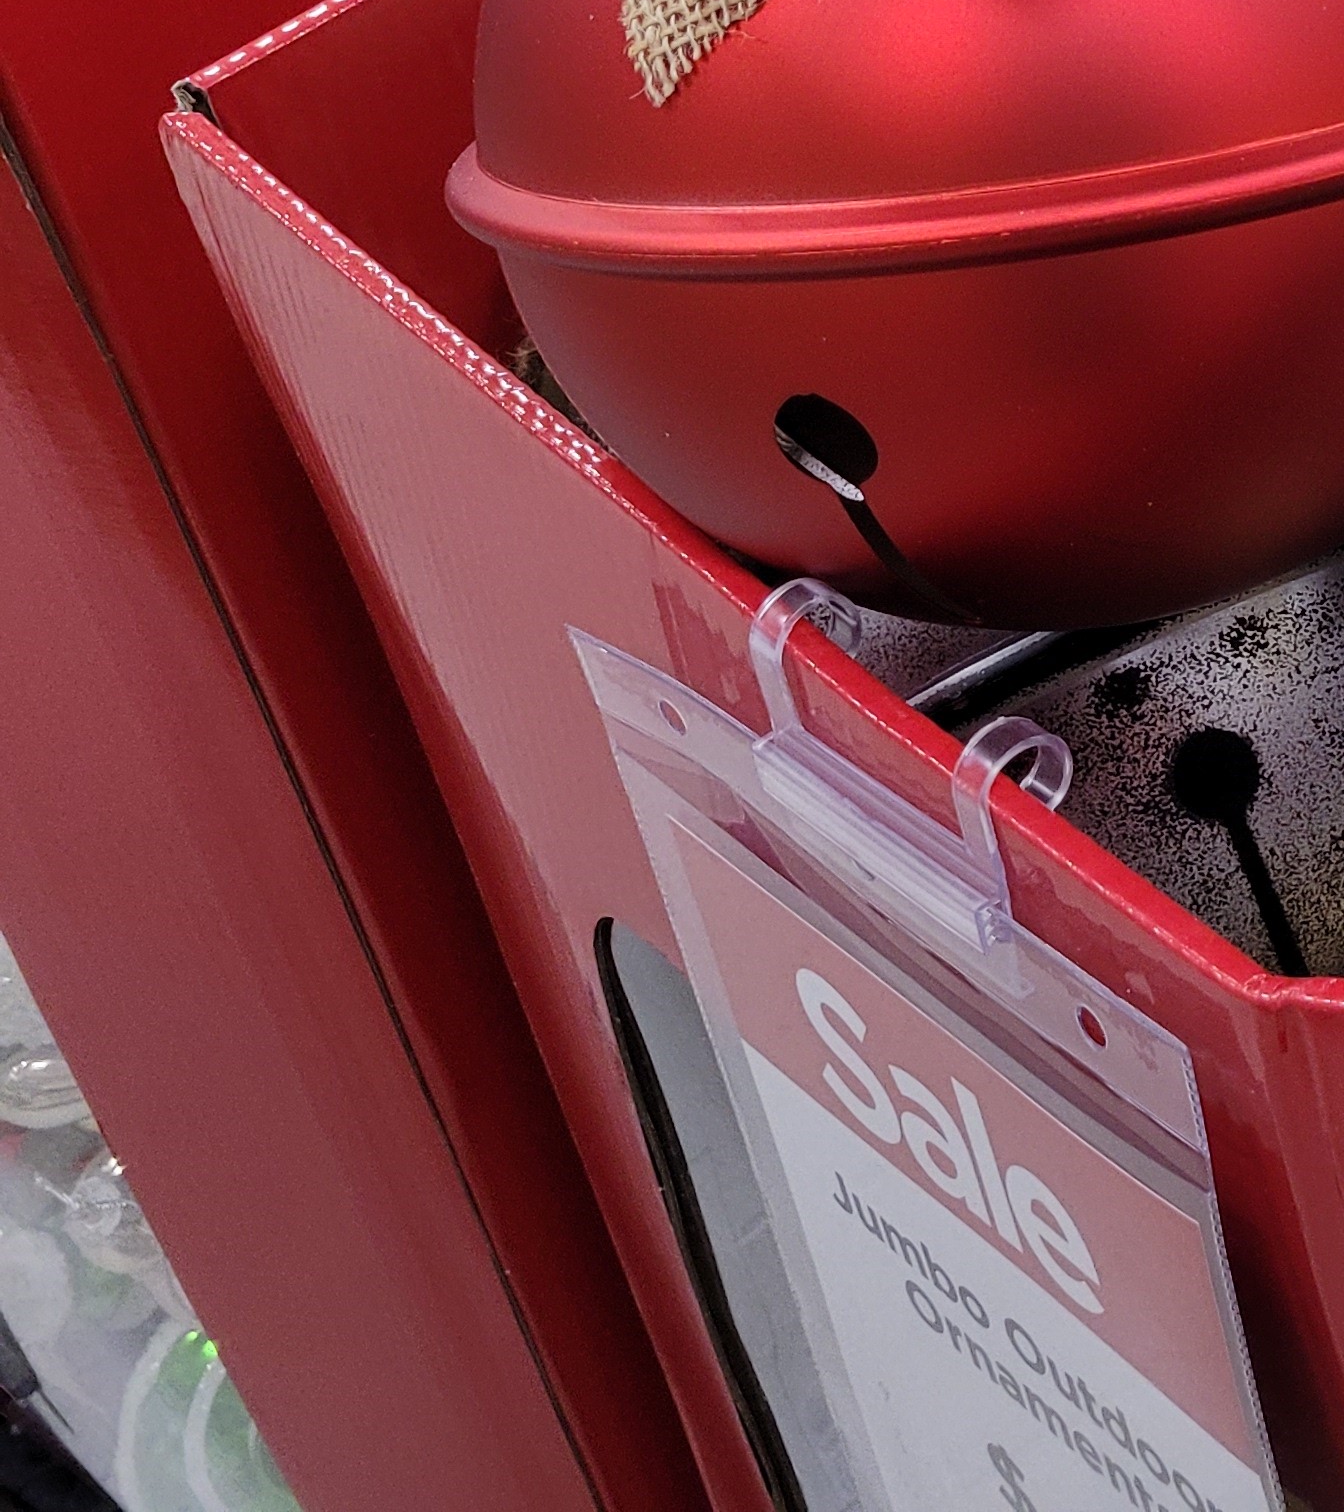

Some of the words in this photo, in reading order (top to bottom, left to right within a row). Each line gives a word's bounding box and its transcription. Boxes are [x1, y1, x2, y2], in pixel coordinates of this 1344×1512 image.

[796, 967, 1105, 1315] Sale
[832, 1171, 991, 1332] Jumbo
[904, 1278, 1169, 1512] Ornament
